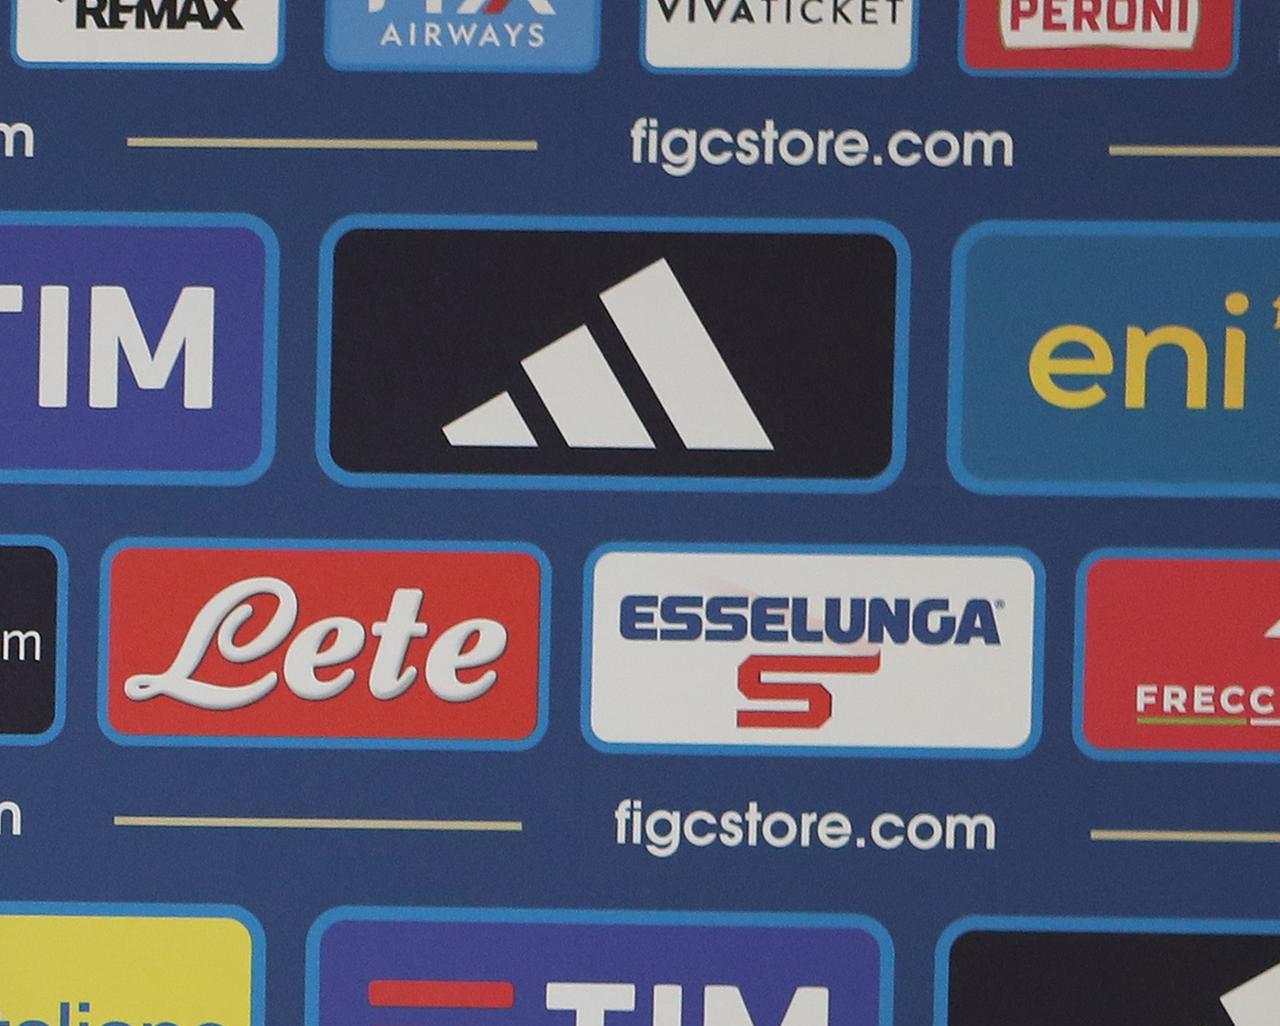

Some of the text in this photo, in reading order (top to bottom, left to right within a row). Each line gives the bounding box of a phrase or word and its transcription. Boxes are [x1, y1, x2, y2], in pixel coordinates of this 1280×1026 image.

[381, 23, 544, 47] AIRWAYS
[658, 0, 903, 24] VIVATICKET
[1011, 0, 1188, 31] PERONI
[631, 118, 1013, 176] figcstore.com
[1029, 293, 1249, 409] eni
[124, 575, 509, 710] Lete
[620, 595, 1001, 645] ESSELUNGA
[615, 799, 995, 857] figcstore.com
